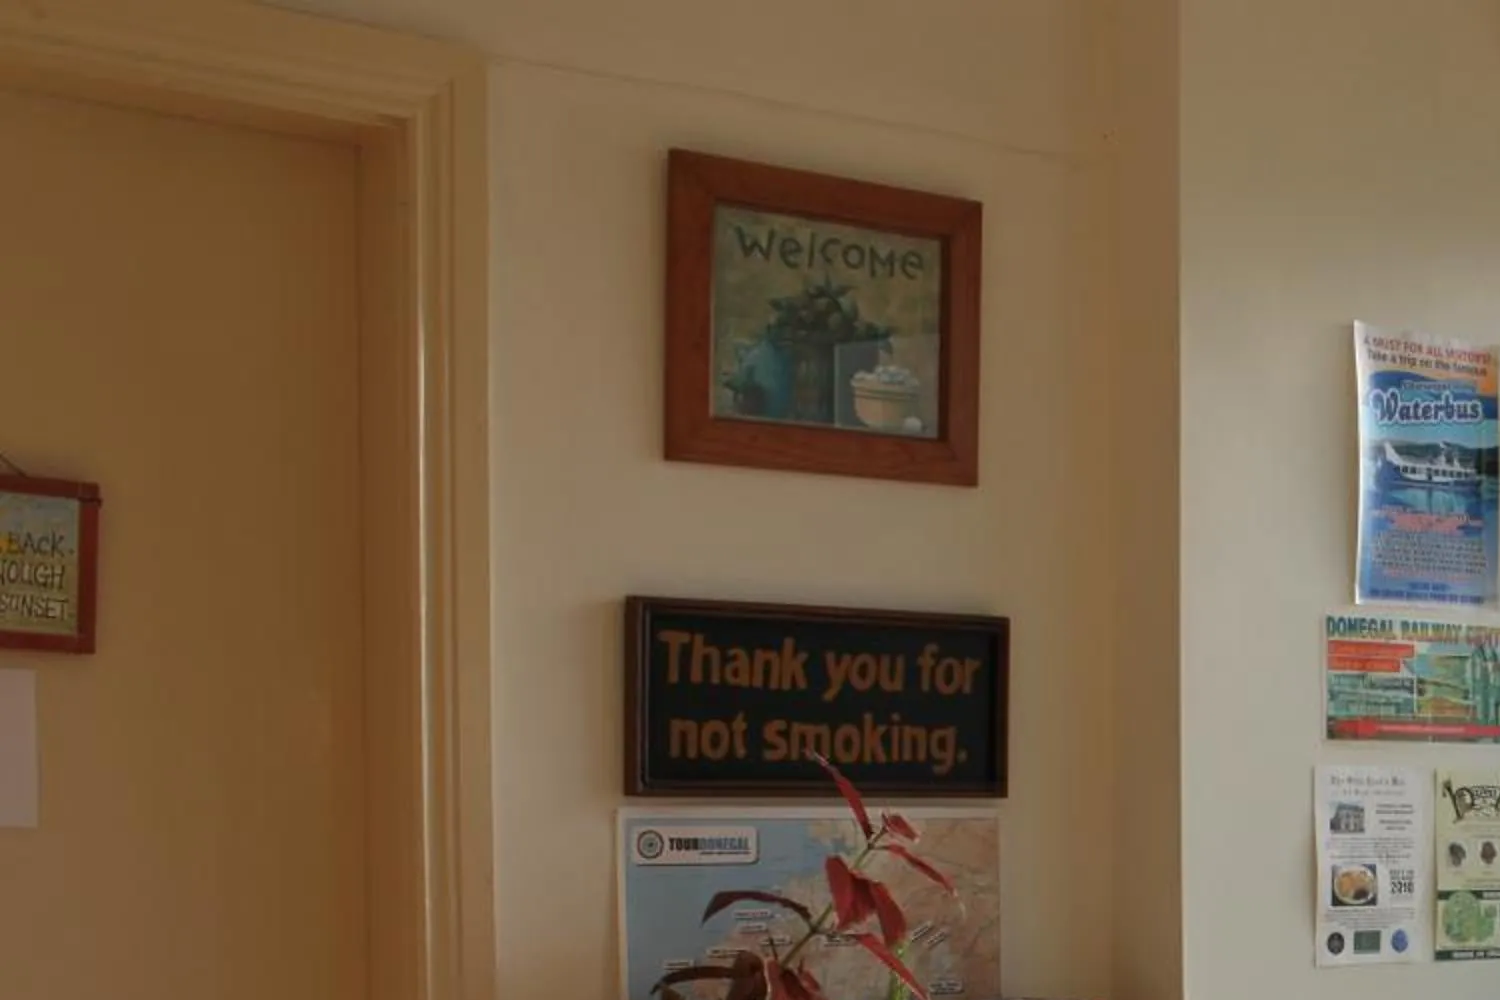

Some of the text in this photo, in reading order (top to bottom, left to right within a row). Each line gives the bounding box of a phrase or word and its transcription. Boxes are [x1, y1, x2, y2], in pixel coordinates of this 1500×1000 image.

[1366, 348, 1388, 362] Take
[1399, 354, 1417, 369] trip
[1435, 358, 1451, 370] the
[1404, 342, 1424, 354] FOR
[1427, 344, 1443, 356] ALL
[1370, 389, 1482, 424] Waterbus
[1326, 616, 1395, 638] DONEGAL
[1401, 619, 1462, 643] RAILWAY
[656, 629, 982, 703] Thank you for
[668, 711, 968, 776] not smoking.
